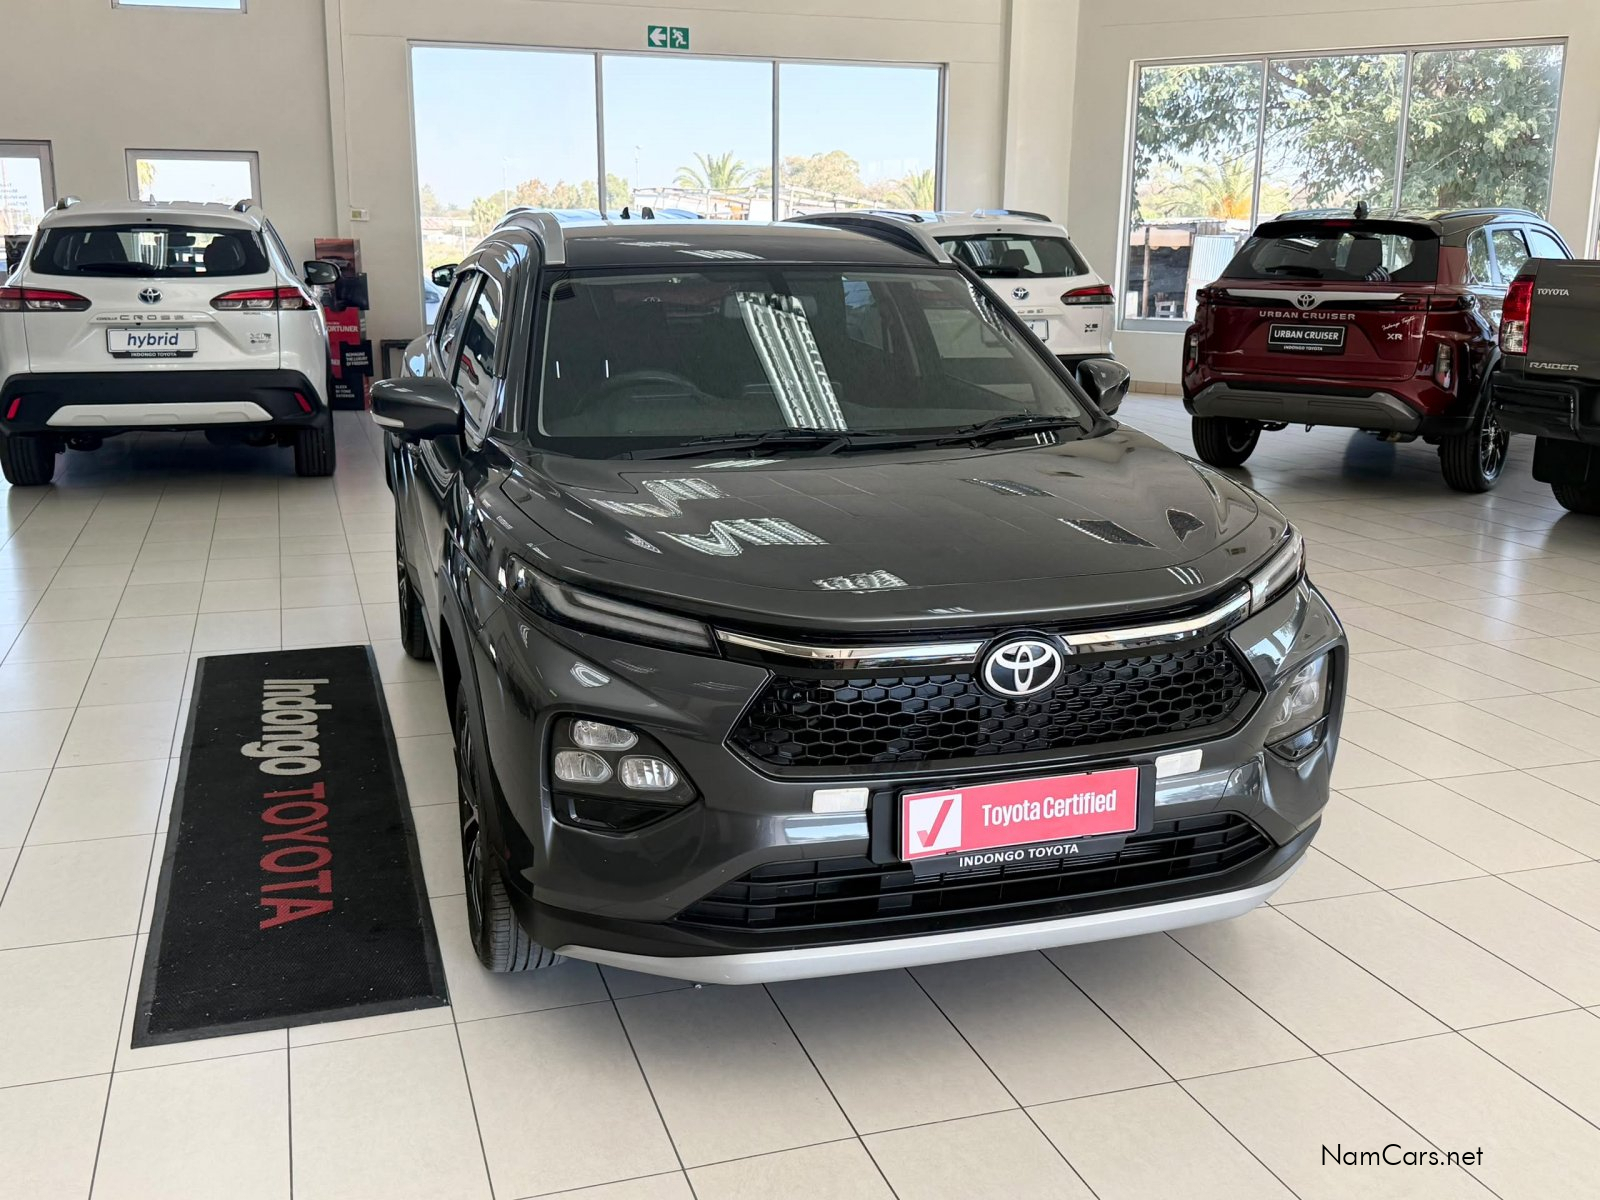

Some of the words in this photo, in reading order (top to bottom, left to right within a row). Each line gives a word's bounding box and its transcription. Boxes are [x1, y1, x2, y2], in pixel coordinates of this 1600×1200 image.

[1537, 288, 1569, 296] TOYOTA
[1259, 310, 1298, 319] URBAN
[1302, 312, 1356, 321] CRUISER
[127, 332, 179, 348] hybrid
[1274, 329, 1304, 339] URBAN
[1304, 331, 1339, 341] CRUISER
[1529, 361, 1579, 371] RAIDER
[241, 678, 332, 776] Indongo
[981, 800, 1041, 827] Toyota
[1043, 789, 1117, 818] Certified
[259, 781, 334, 930] TOYOTA
[959, 849, 1026, 867] INDONGO
[1028, 843, 1079, 859] TOYOTA
